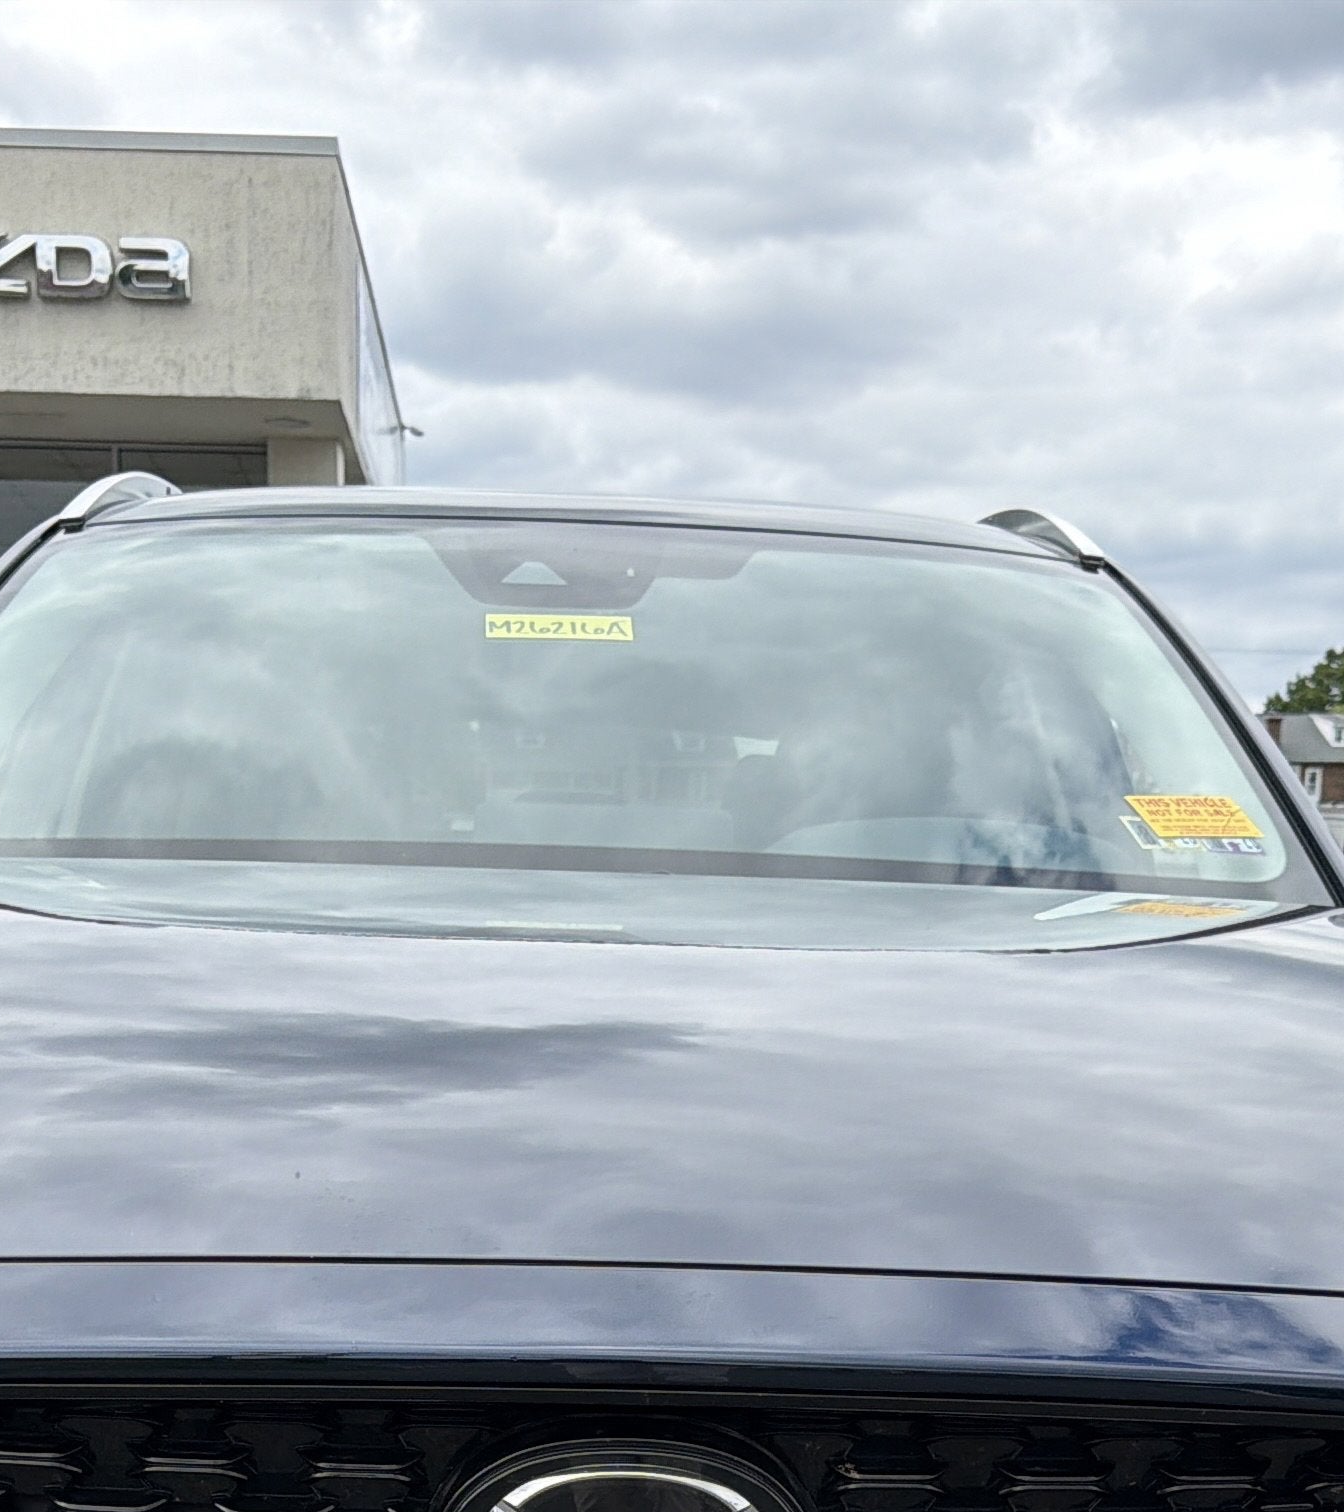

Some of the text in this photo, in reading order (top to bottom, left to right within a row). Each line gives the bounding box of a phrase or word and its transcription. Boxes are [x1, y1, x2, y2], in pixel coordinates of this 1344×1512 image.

[1135, 798, 1233, 809] THIS VEHICLE
[1146, 809, 1171, 817] NOT
[1176, 809, 1203, 817] FOR
